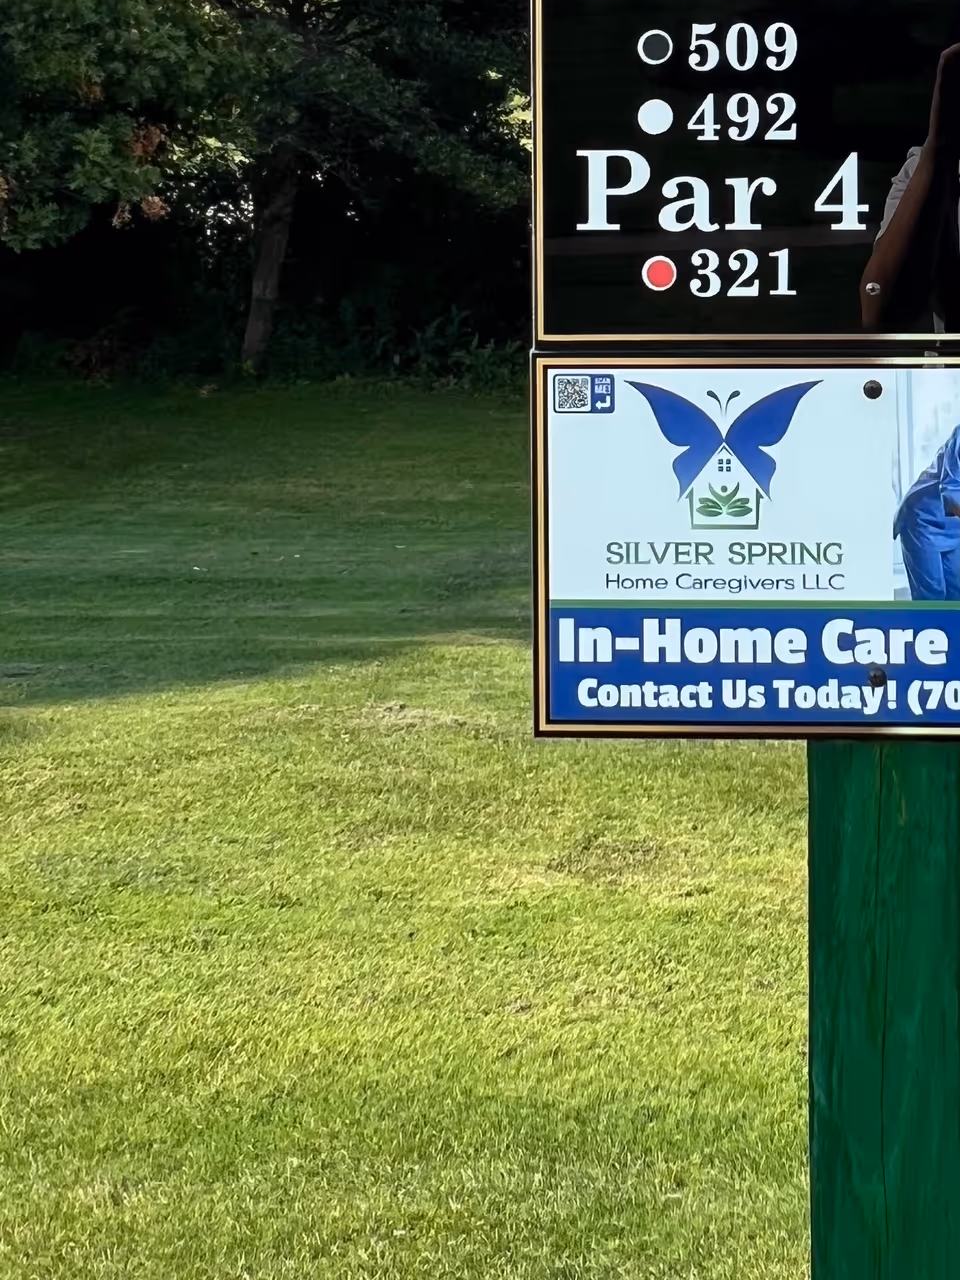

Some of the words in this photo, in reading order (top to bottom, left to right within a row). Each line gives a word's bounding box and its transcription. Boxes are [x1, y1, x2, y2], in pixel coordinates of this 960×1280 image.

[688, 22, 798, 72] 509
[687, 92, 798, 142] 492
[576, 149, 777, 233] Par
[814, 151, 869, 231] 4
[689, 248, 797, 297] 321
[606, 541, 715, 565] SILVER
[728, 541, 844, 566] SPRING
[606, 572, 669, 590] Home
[675, 572, 796, 594] Caregivers
[802, 573, 846, 591] LLC
[558, 618, 807, 664] In-Home
[821, 618, 949, 665] Care
[577, 677, 713, 710] Contact
[721, 679, 766, 710] Us
[772, 678, 897, 715] Today!
